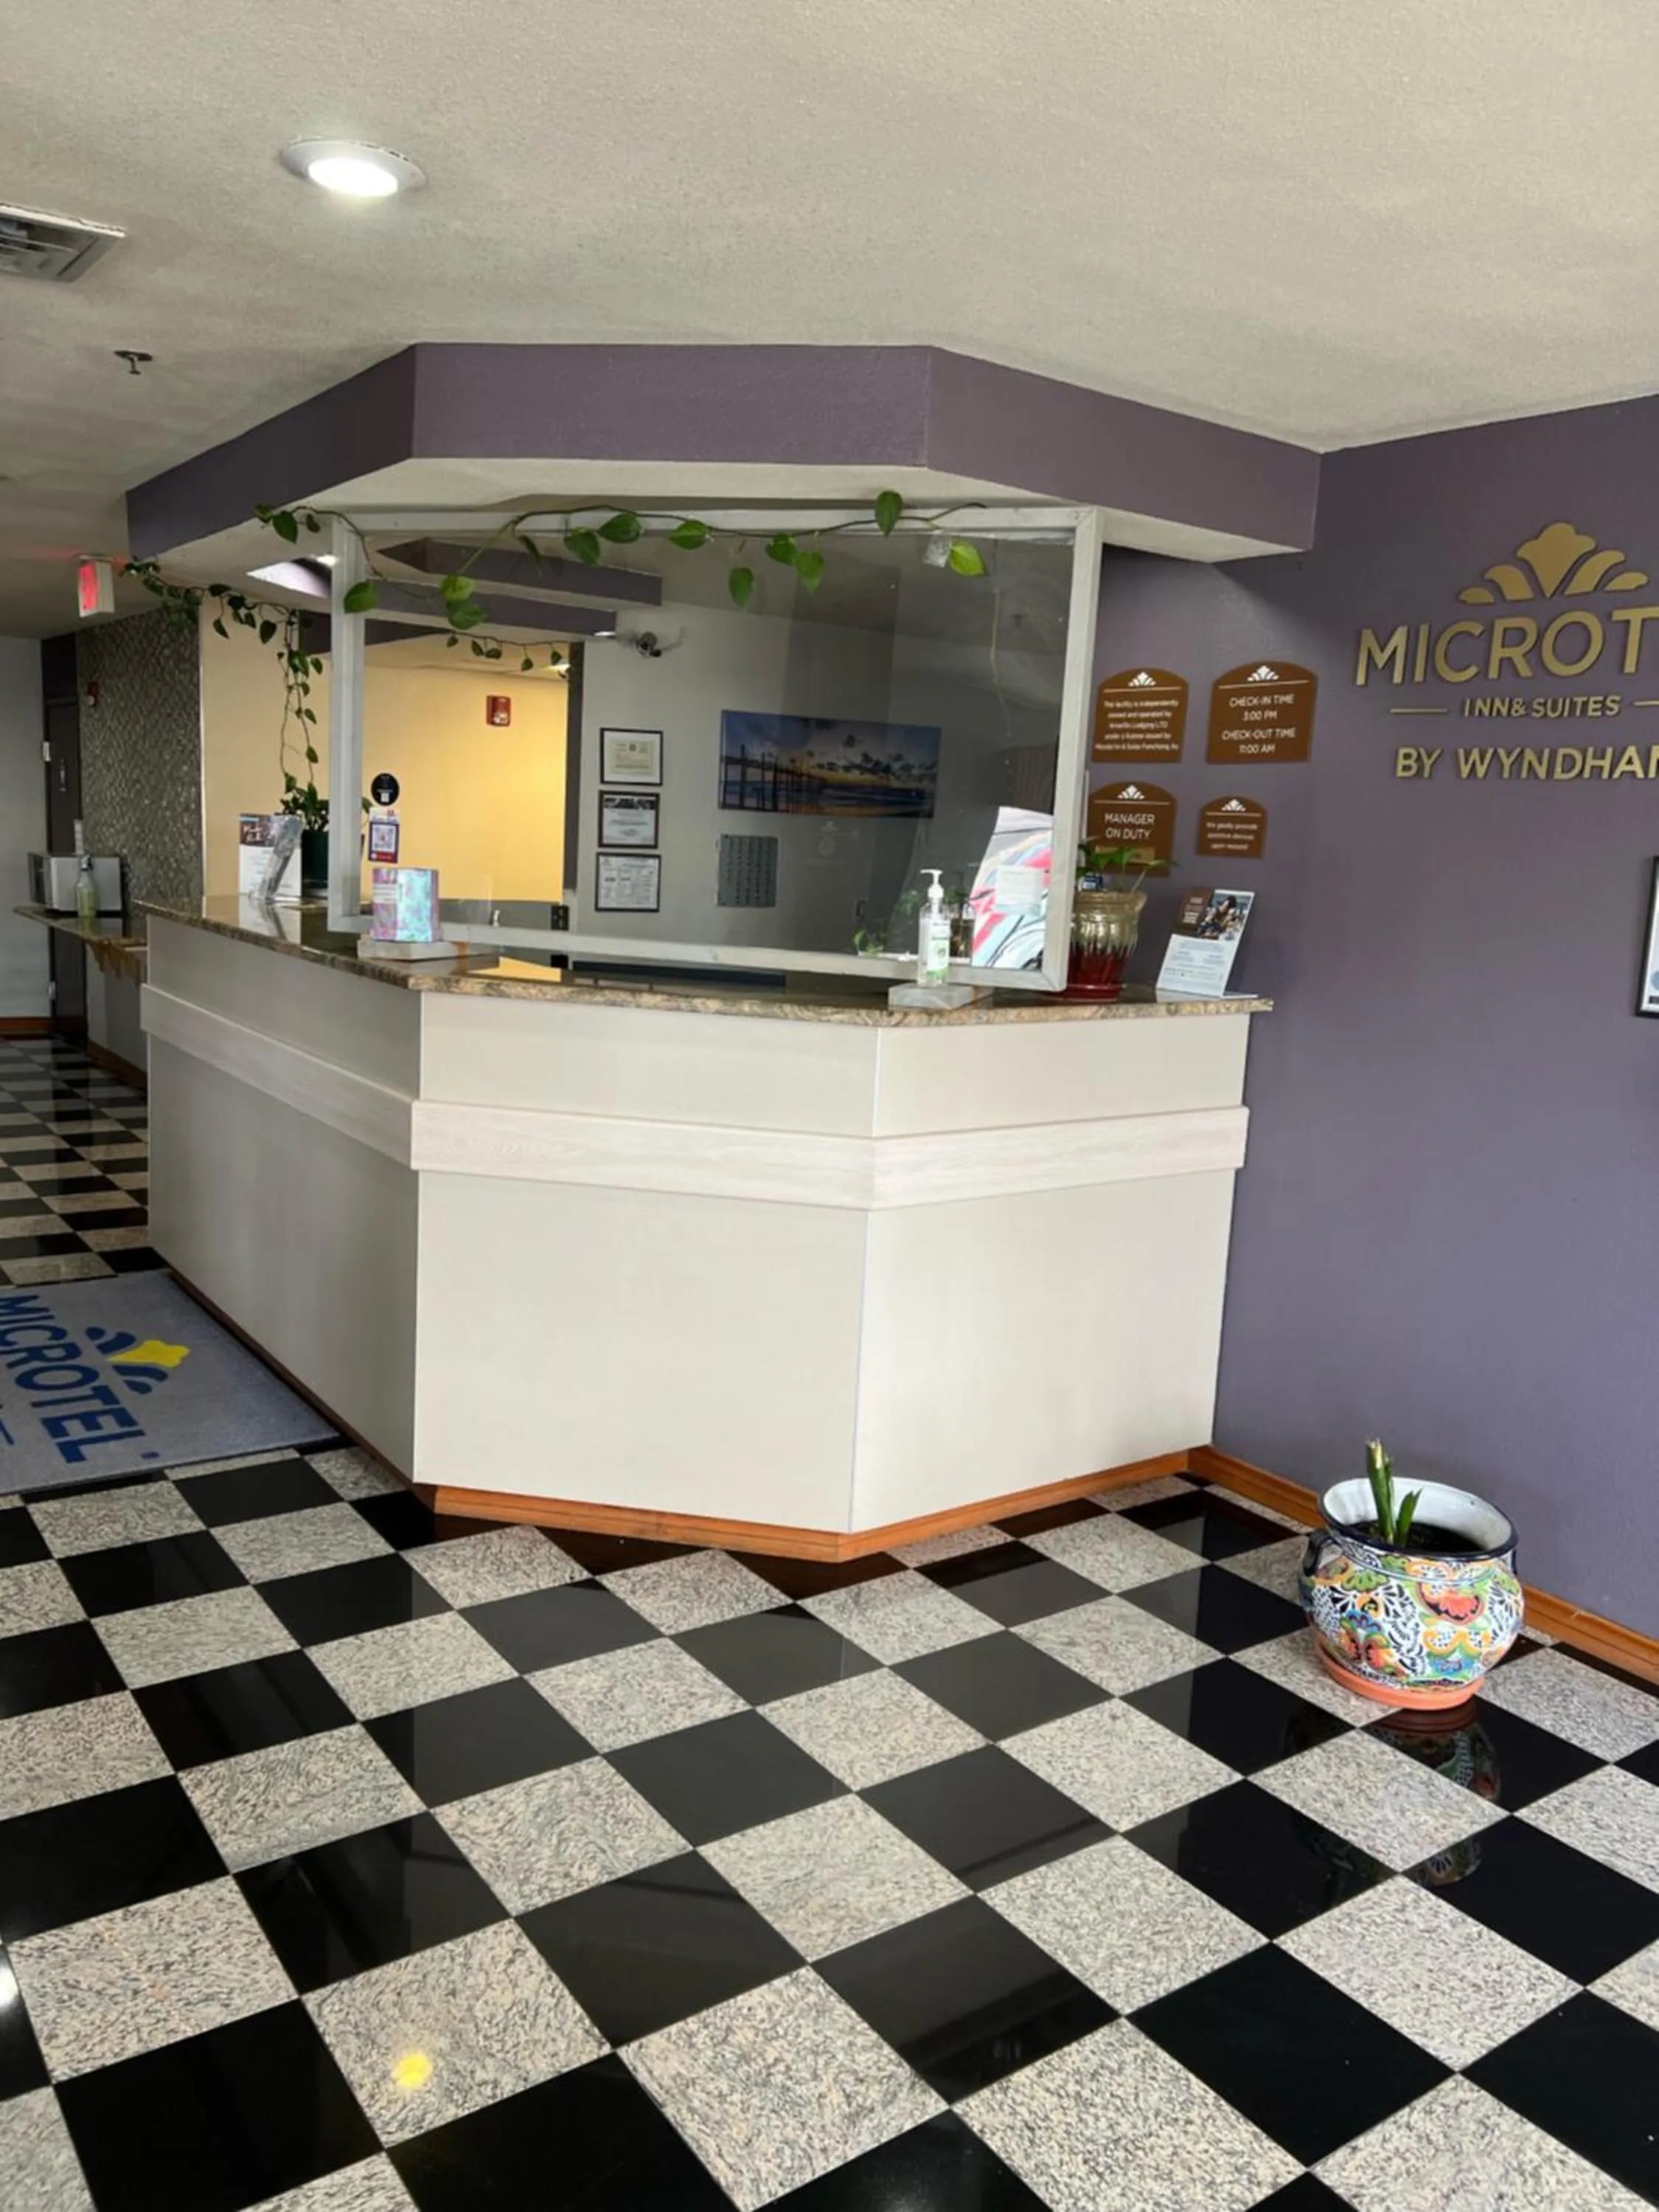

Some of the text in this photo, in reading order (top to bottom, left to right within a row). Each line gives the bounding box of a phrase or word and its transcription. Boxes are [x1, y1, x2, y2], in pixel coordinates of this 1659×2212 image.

[1228, 694, 1295, 708] CHECK-IN TIME
[1531, 695, 1621, 718] SUITES
[1264, 709, 1278, 720] PM
[1222, 727, 1295, 740] CHECK-OUT TIME
[1260, 743, 1276, 754] AM
[1396, 747, 1442, 779] BY
[1104, 813, 1155, 825] MANAGER
[1105, 827, 1152, 840] ON DUTY
